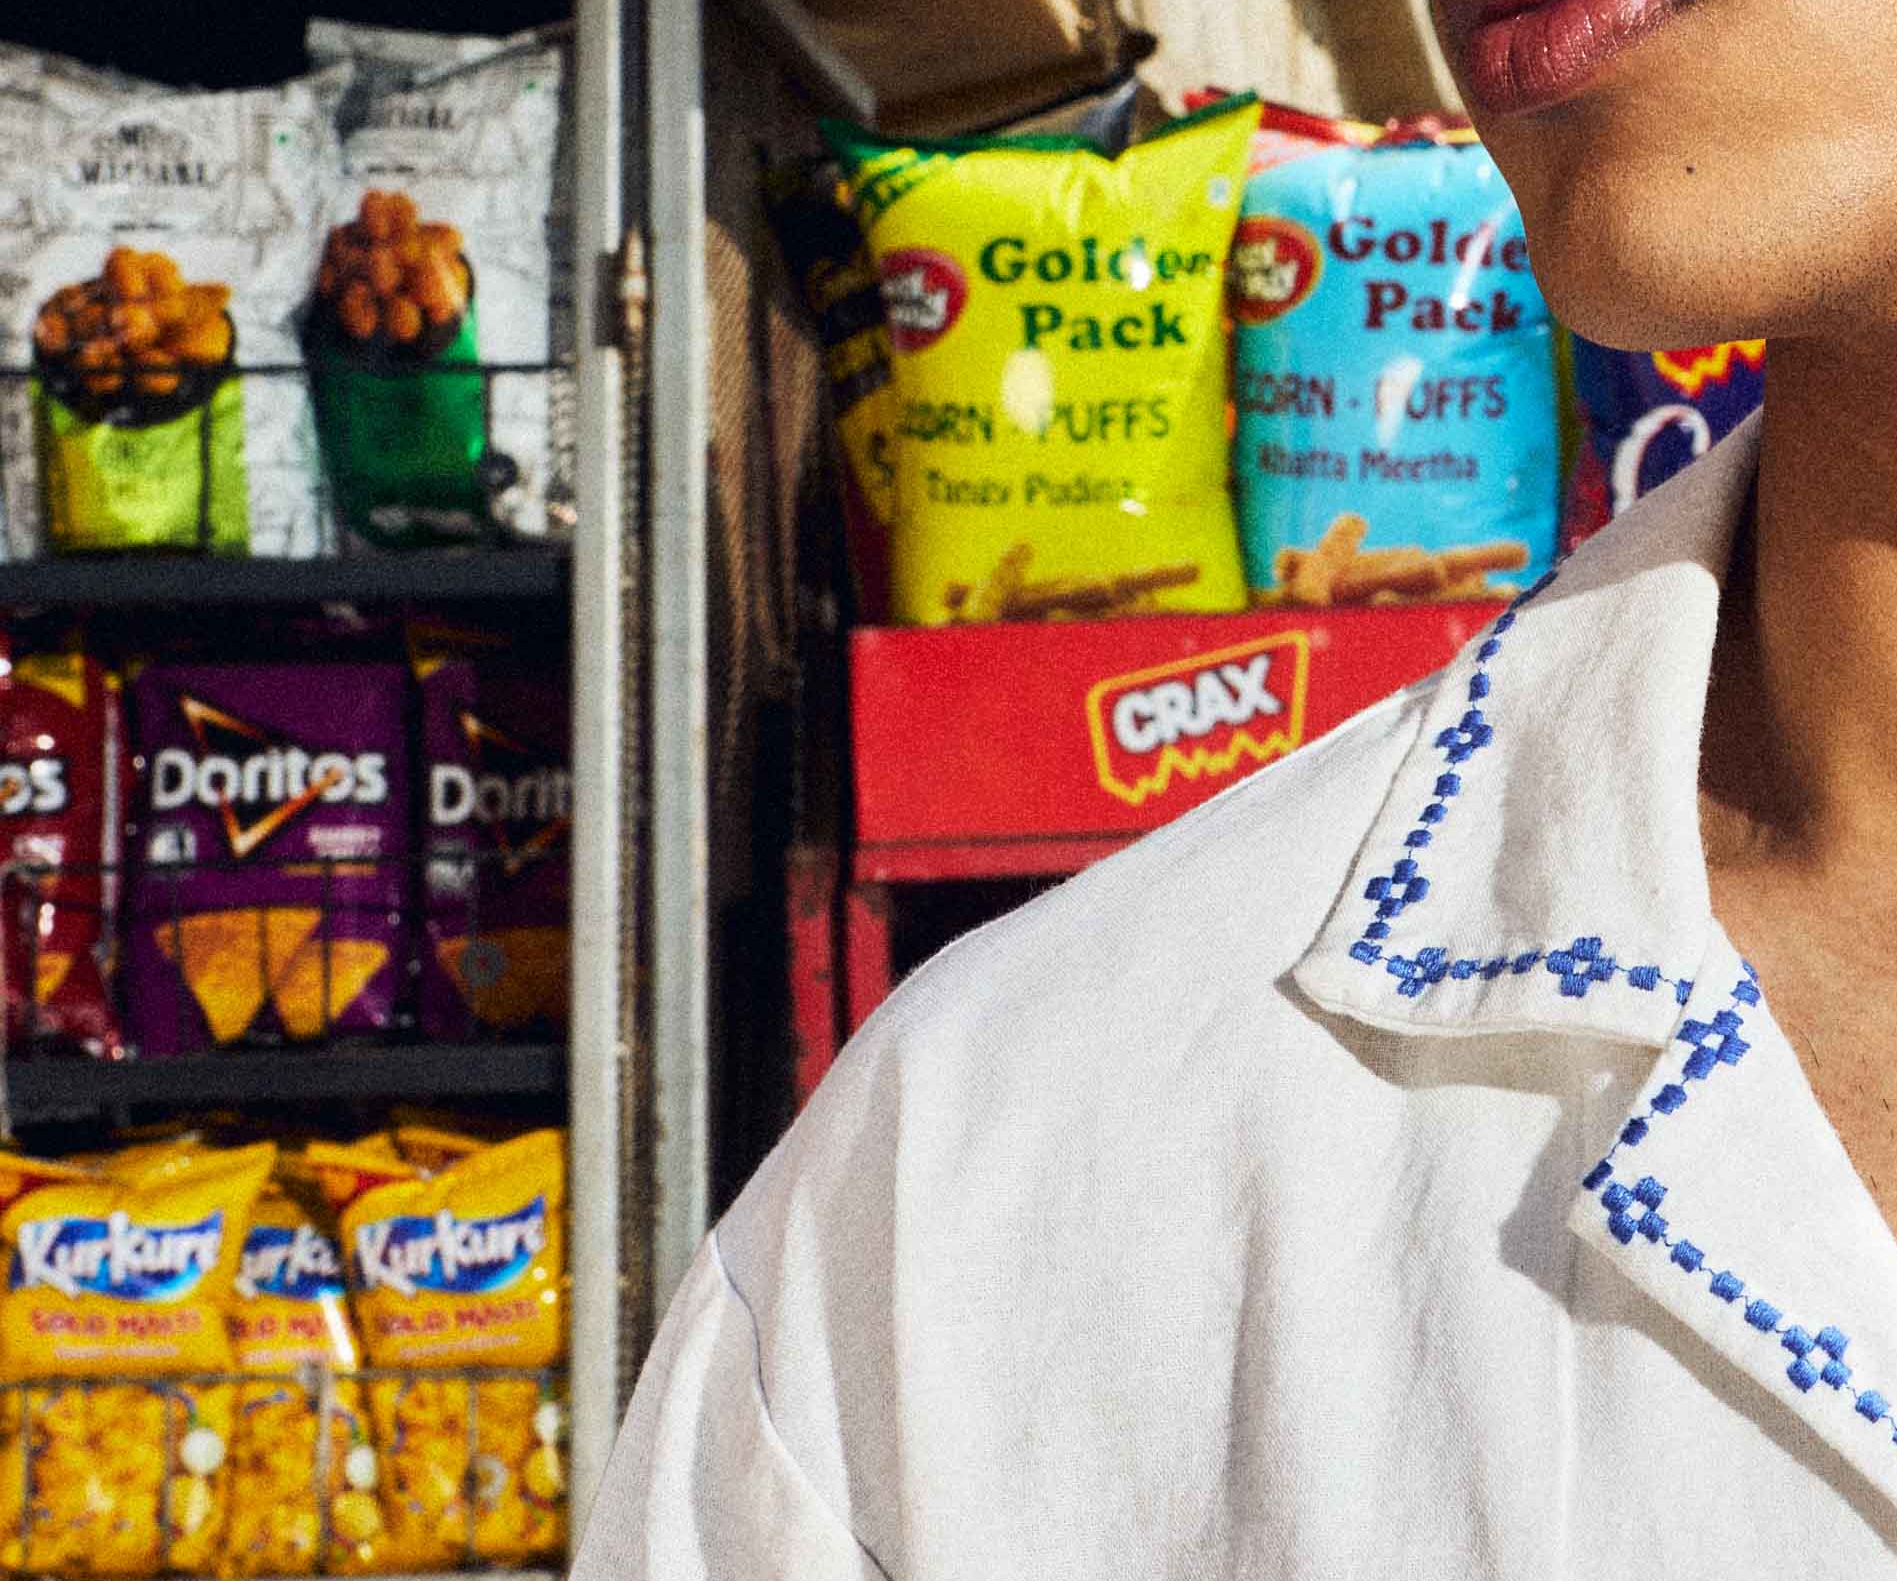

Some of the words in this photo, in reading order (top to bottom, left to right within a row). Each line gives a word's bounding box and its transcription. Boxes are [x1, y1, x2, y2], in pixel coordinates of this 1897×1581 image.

[1326, 216, 1529, 272] Golde
[1019, 302, 1188, 352] Pack
[1363, 280, 1524, 333] Pack
[1112, 652, 1286, 755] CRAX
[152, 748, 389, 810] Doritos
[430, 764, 571, 825] Dorit
